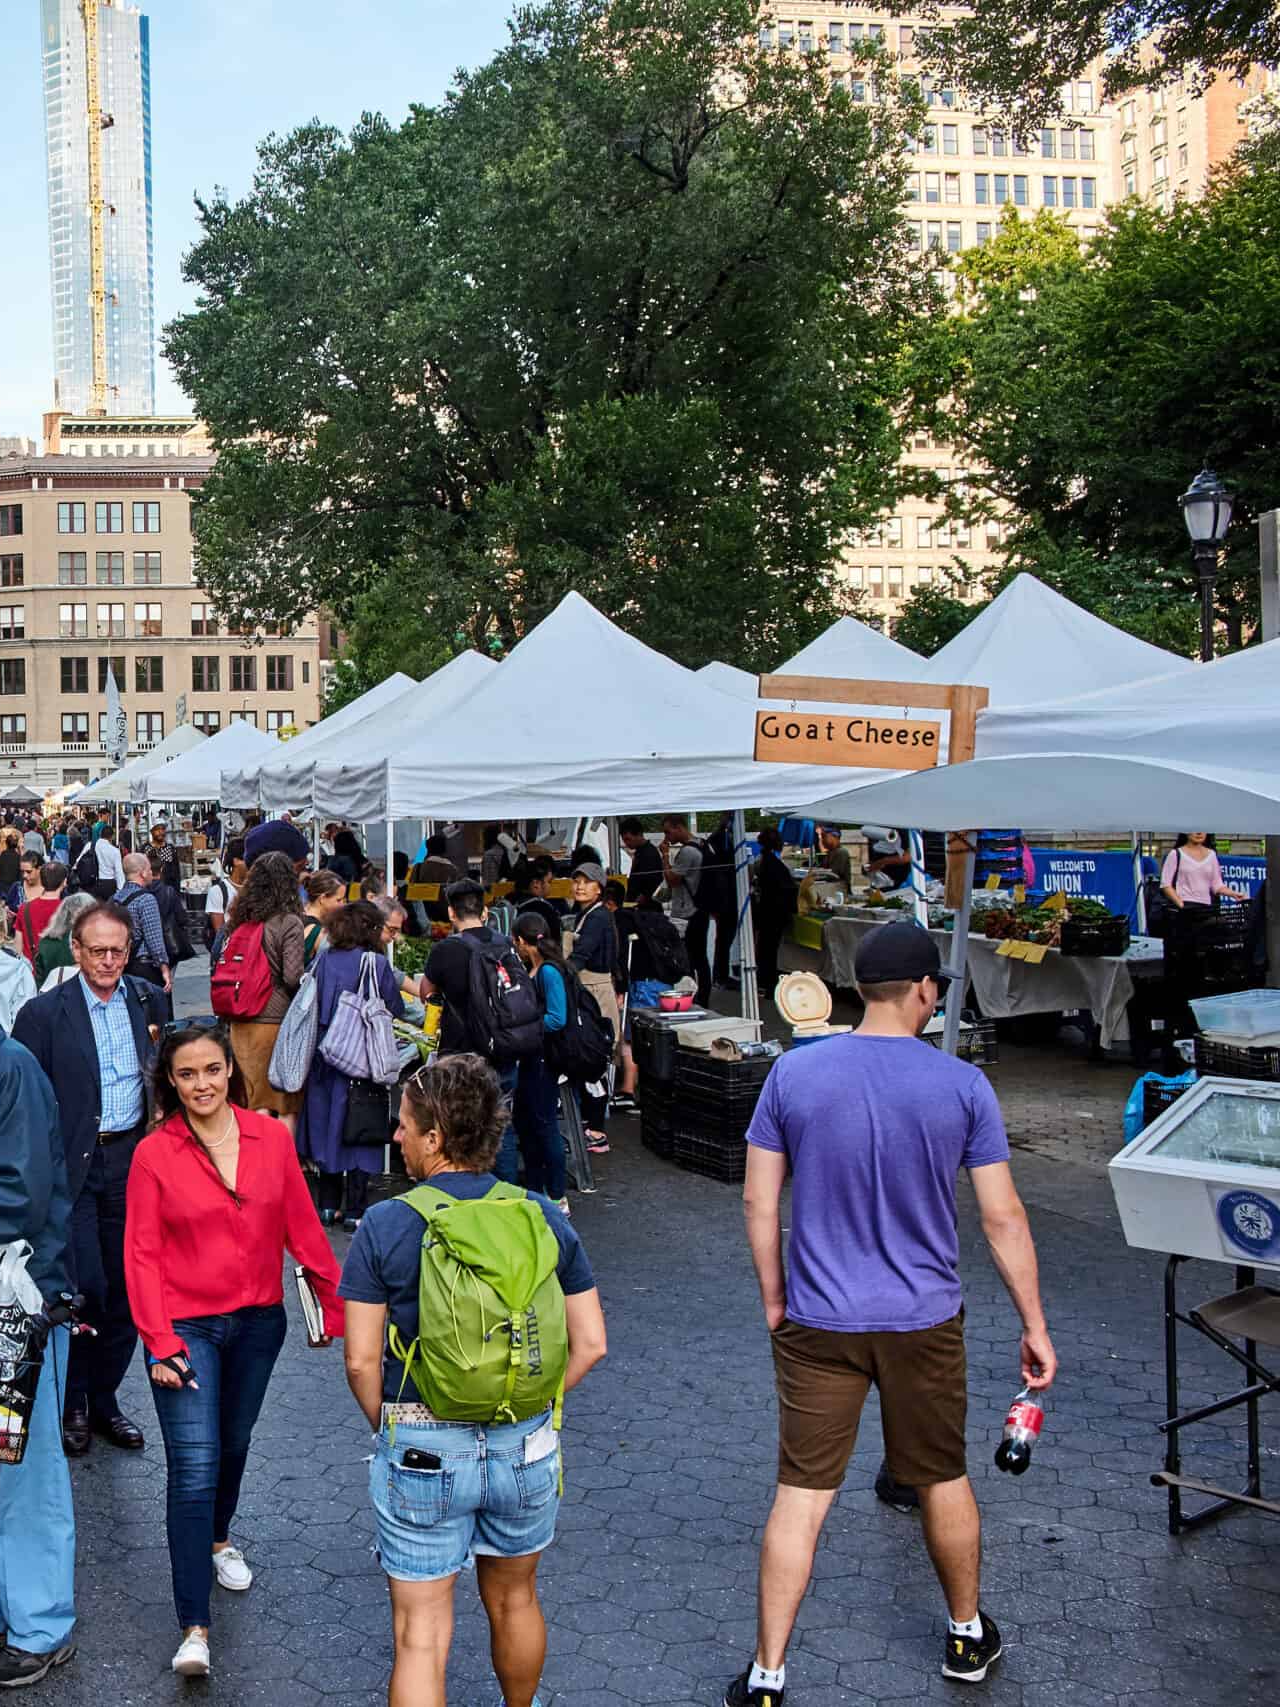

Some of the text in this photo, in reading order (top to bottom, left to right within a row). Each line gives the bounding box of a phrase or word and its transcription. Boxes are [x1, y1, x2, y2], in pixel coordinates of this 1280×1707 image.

[761, 716, 935, 746] Goat Cheese
[1049, 860, 1096, 872] WELCOME TO
[1220, 865, 1256, 880] ELCOME
[1043, 874, 1082, 893] UNION
